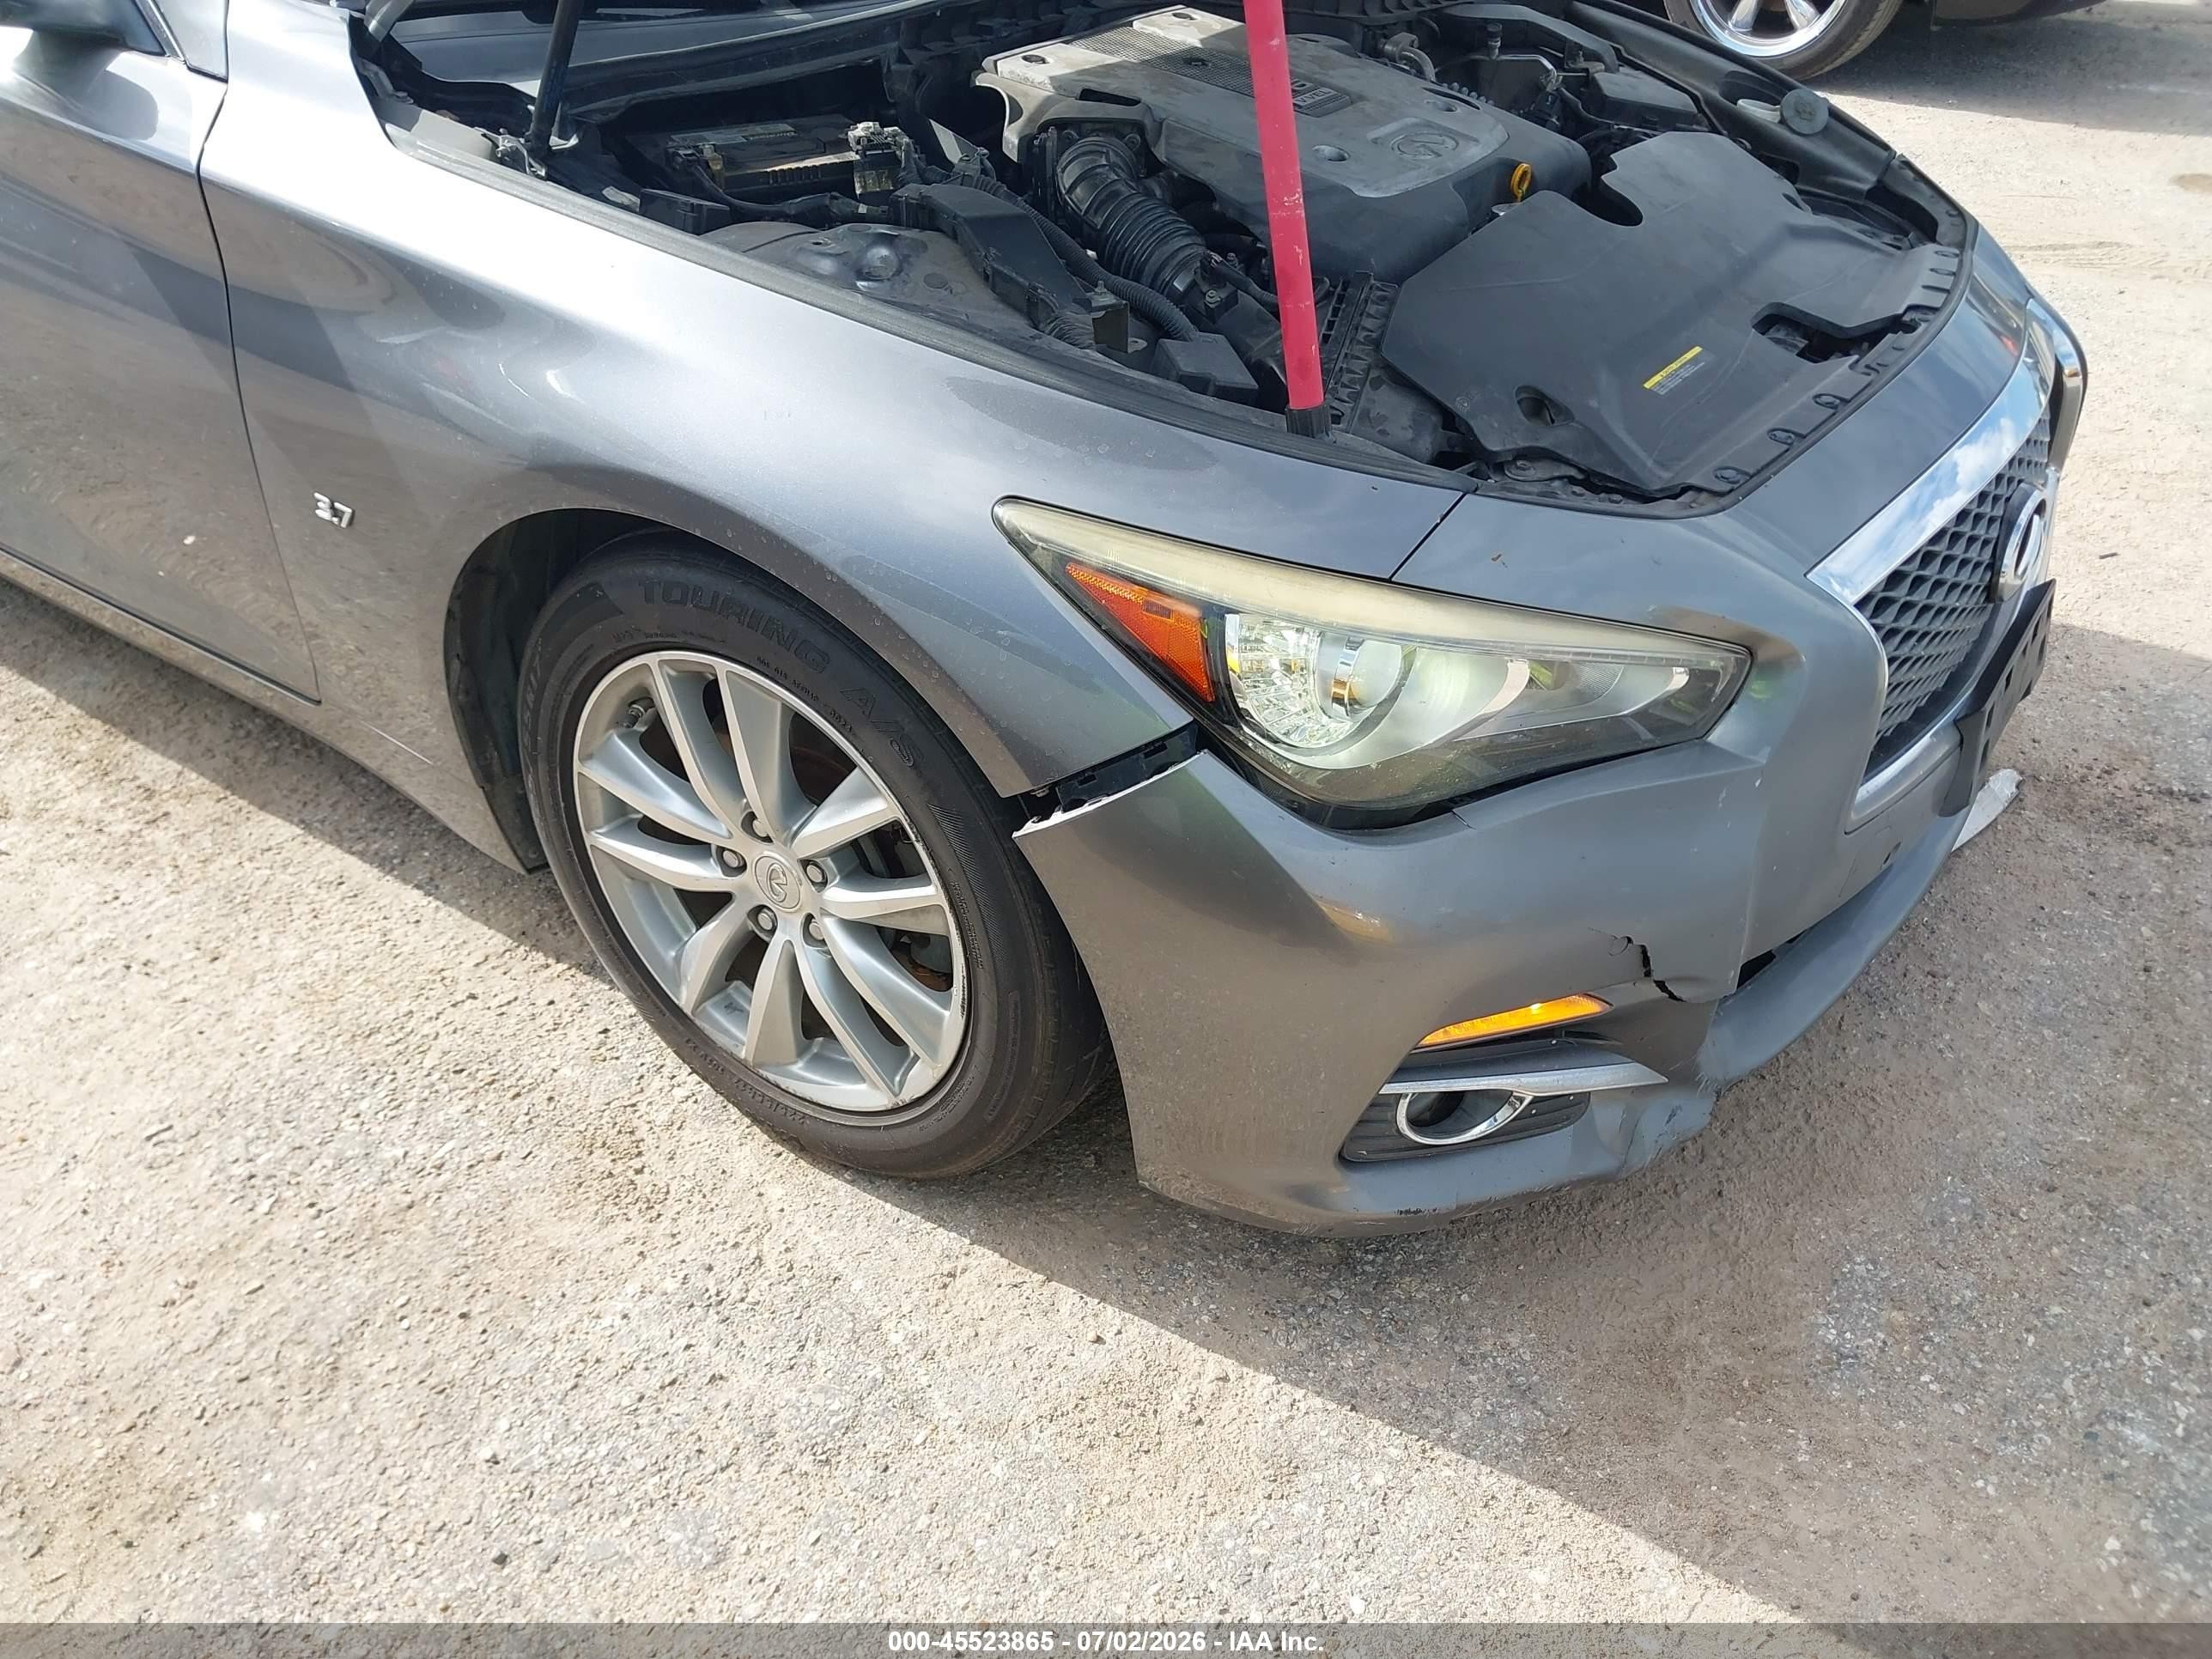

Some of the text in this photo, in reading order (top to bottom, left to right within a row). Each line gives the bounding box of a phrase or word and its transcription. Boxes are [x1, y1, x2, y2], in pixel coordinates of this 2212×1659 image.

[313, 491, 353, 529] 3.7
[639, 580, 831, 675] TOURING
[839, 687, 925, 770] A/S
